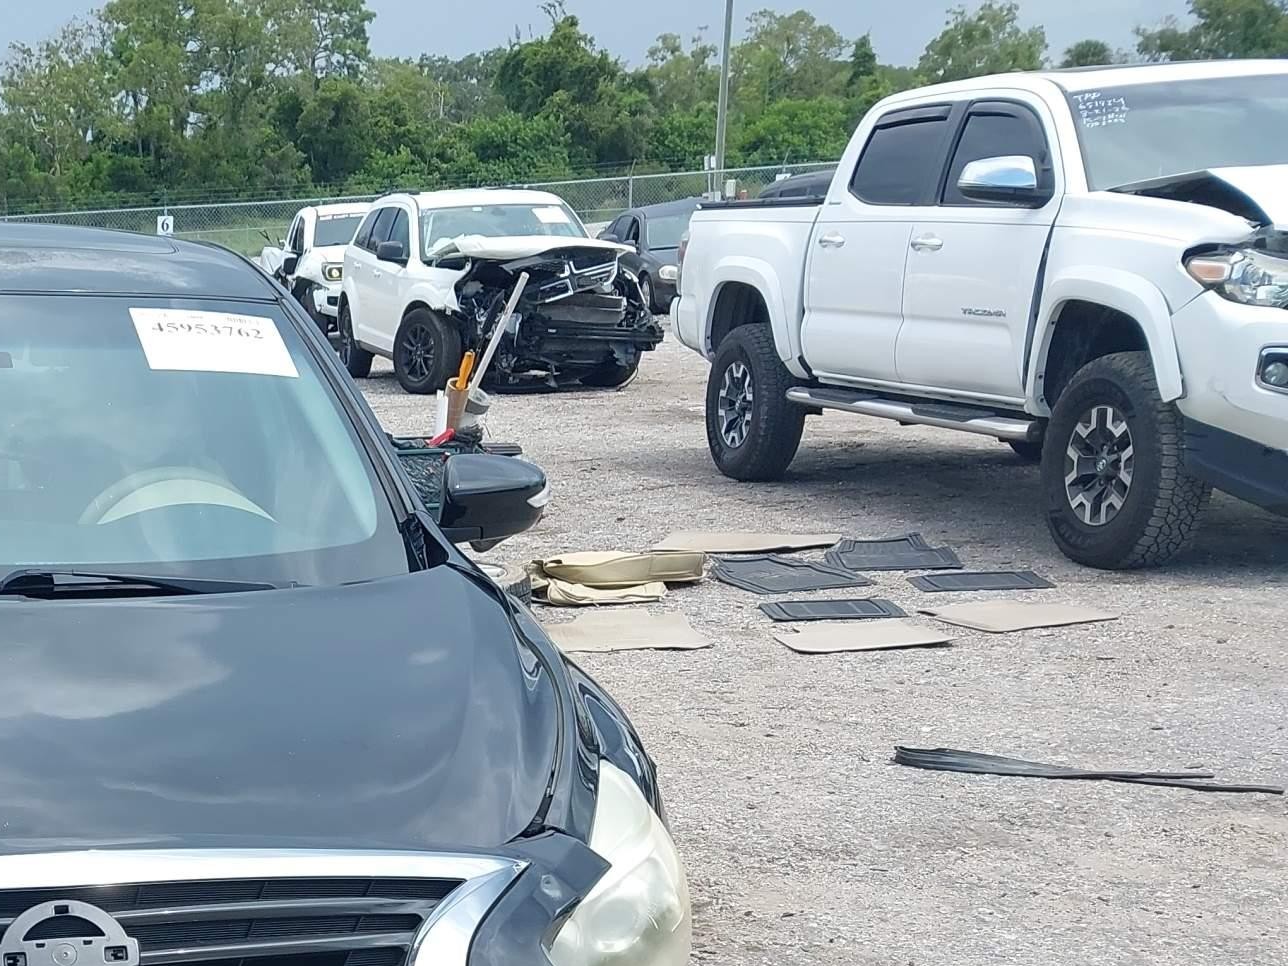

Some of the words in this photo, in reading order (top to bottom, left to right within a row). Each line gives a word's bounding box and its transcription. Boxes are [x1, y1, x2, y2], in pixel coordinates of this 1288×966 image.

[161, 217, 169, 232] 6
[960, 307, 1007, 318] TACOMA
[151, 322, 265, 340] 45953762
